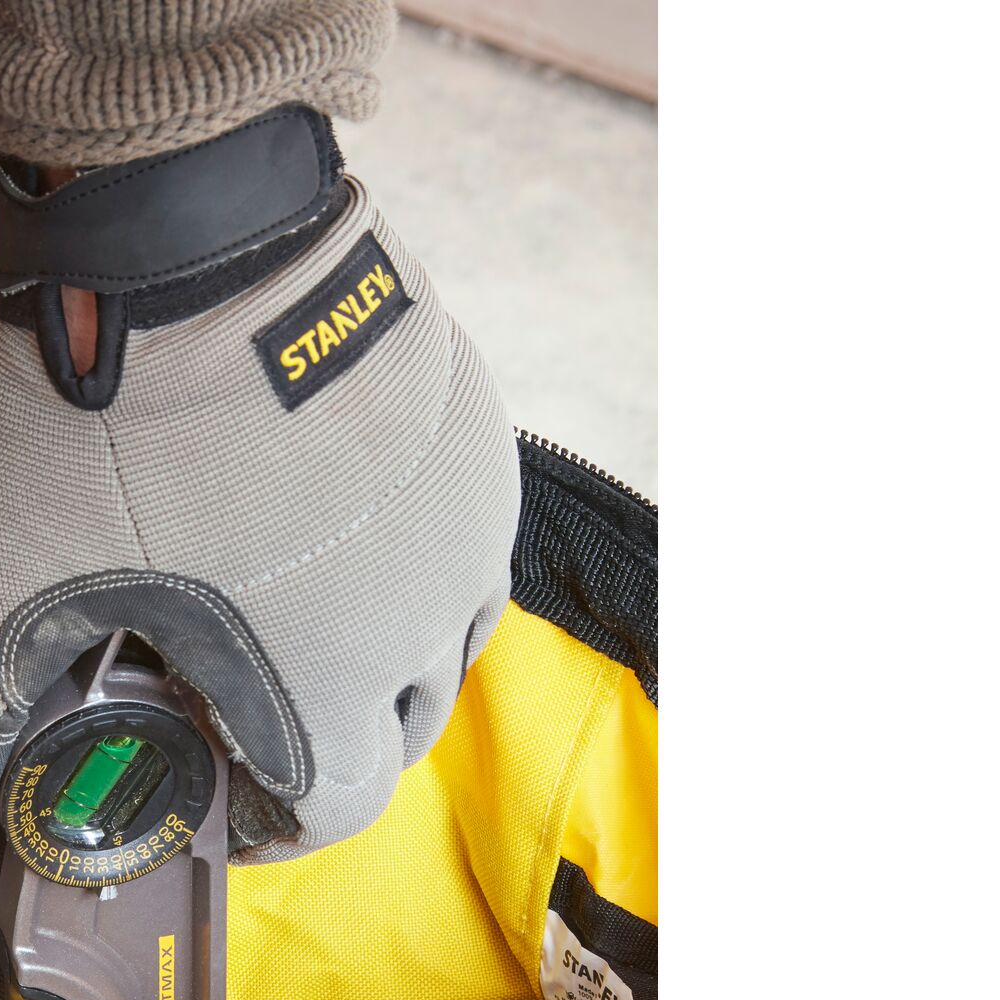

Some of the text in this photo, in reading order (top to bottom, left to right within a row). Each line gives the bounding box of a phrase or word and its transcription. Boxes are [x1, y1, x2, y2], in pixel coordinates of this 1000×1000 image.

[280, 263, 391, 381] STANLEY
[19, 764, 186, 873] 90 80 70 60 50 40 30 20 10 0 10 20 30 40 50 60 70 80 90
[39, 807, 52, 817] 45
[113, 835, 122, 846] 45
